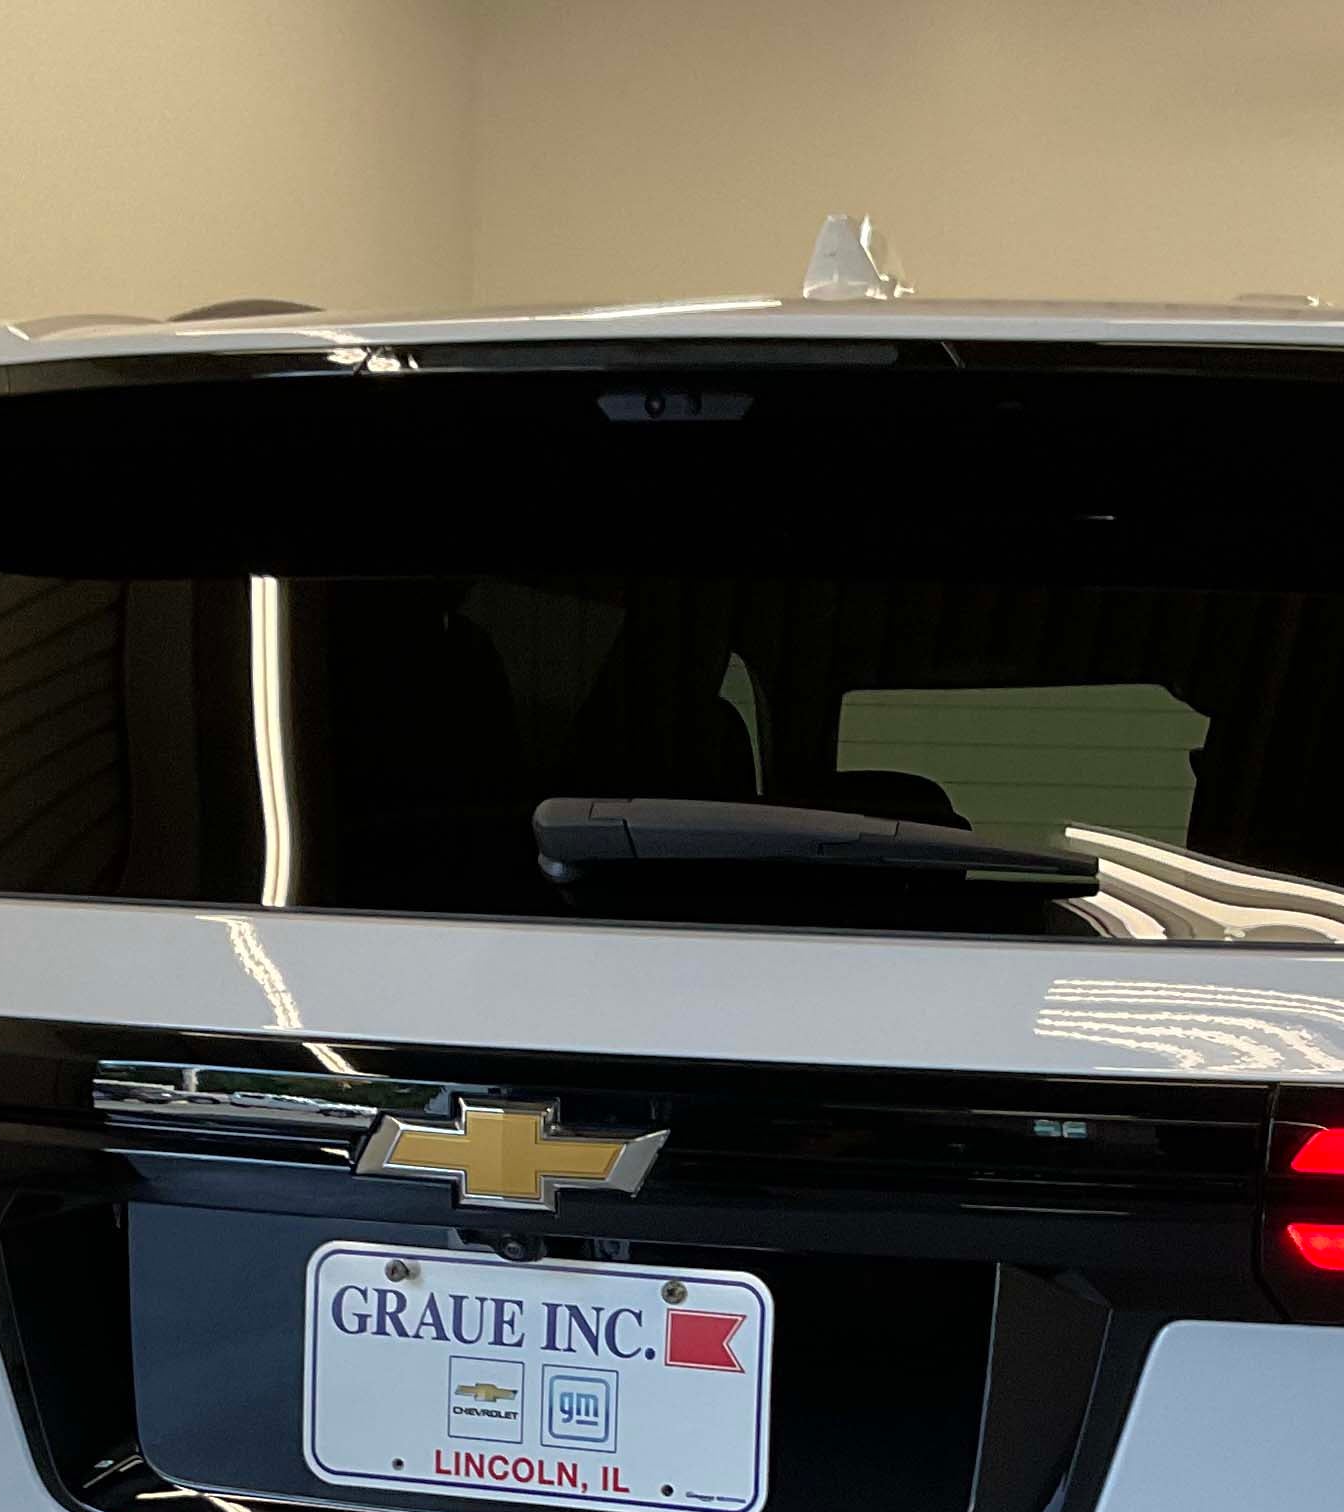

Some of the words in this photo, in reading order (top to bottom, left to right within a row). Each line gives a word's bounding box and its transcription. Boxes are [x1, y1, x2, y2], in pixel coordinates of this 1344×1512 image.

[331, 1284, 524, 1347] GRAUE
[540, 1302, 656, 1361] INC.
[452, 1406, 518, 1421] CHEVROLET
[559, 1391, 599, 1425] gm
[435, 1449, 589, 1494] LINCOLN,
[601, 1466, 630, 1494] IL
